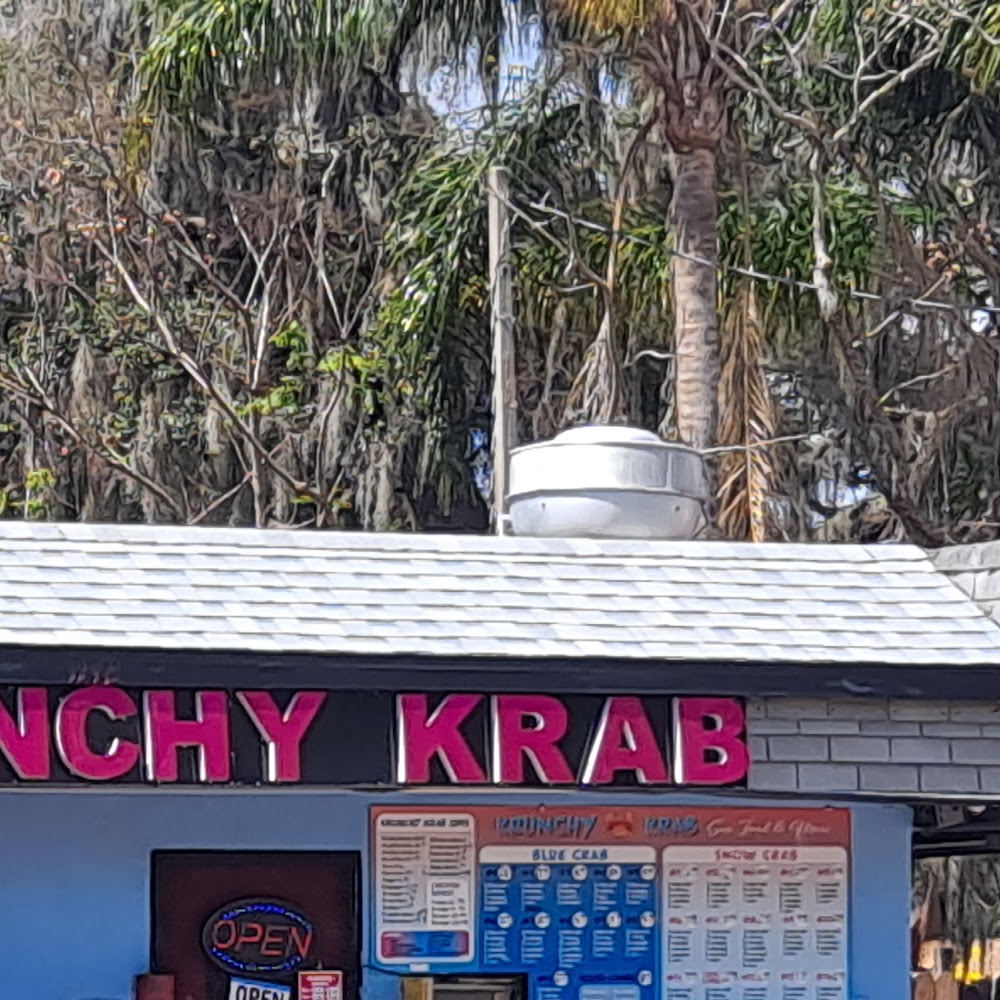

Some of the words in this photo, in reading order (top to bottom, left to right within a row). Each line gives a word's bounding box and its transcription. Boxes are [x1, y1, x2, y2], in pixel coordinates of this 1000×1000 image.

[396, 693, 750, 786] KRAB
[532, 848, 567, 861] BLUE
[571, 848, 609, 861] CRAB
[212, 919, 313, 958] OPEN
